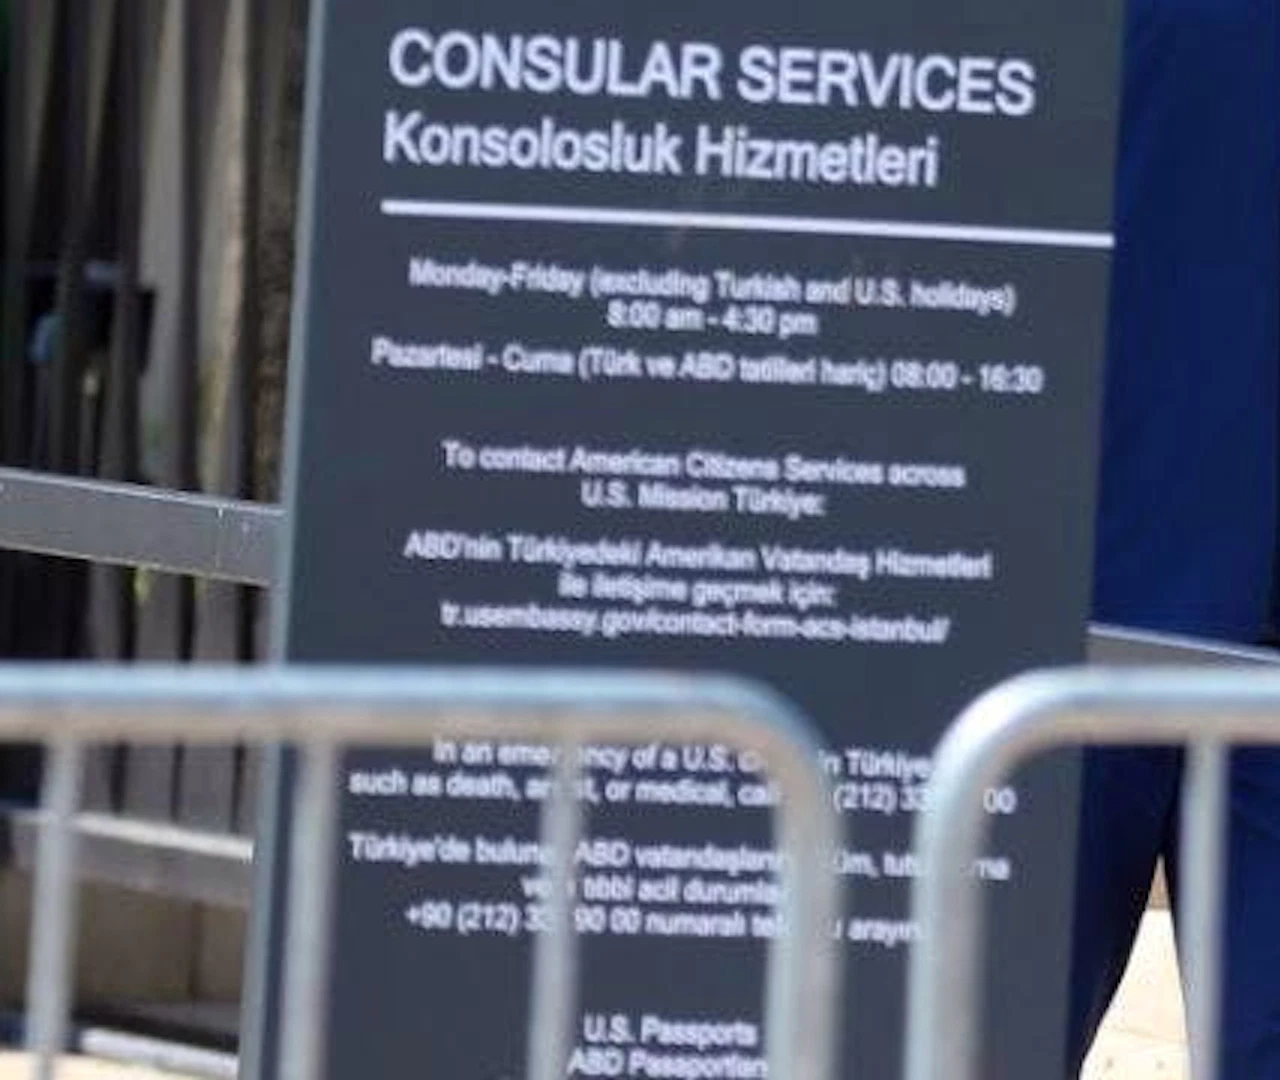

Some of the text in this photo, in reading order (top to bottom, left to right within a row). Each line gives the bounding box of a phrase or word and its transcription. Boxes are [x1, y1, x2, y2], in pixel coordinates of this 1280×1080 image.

[388, 27, 1037, 118] CONSULAR SERVICES
[382, 110, 940, 188] Konsolosluk Hizmetleri
[408, 257, 1017, 317] Monday-Friday (excluding Turkish and U.S. holidays)
[607, 299, 663, 329] 8:00
[666, 307, 705, 331] am
[722, 304, 777, 334] 4:30
[779, 311, 820, 340] pm
[370, 335, 485, 371] Pazartesi
[502, 342, 575, 375] Cuma
[577, 345, 643, 383] (Türk
[646, 355, 676, 379] ve
[678, 351, 737, 382] ABD
[739, 356, 817, 386] tatilleri
[820, 358, 888, 394] hariç)
[890, 359, 960, 391] 08:00
[979, 364, 1045, 395] 16:30
[442, 439, 968, 489] To contact American Citizens Services across
[580, 478, 829, 520] U.S. Mission Türkiye:
[403, 530, 502, 564] ABD'nin
[644, 540, 757, 574] Amerikan
[759, 544, 871, 584] Vatandaş
[874, 548, 992, 582] Hizmetleri
[557, 573, 589, 599] ile
[591, 574, 687, 606] iletişime
[692, 579, 783, 610] geçmek
[439, 599, 952, 645] tr.usembassy.gov/contact-form-acs-istanbul/
[432, 738, 457, 763] In
[461, 743, 493, 765] an
[631, 742, 659, 770] of
[660, 751, 678, 771] a
[683, 746, 735, 774] U.S.
[348, 770, 408, 796] such
[411, 775, 441, 797] as
[445, 771, 522, 802] death,
[604, 781, 633, 804] or
[634, 779, 734, 809] medical,
[832, 783, 898, 816] (212)
[347, 831, 631, 869] Türkiye'de ABD
[637, 876, 681, 903] acil
[403, 902, 453, 931] +90
[457, 902, 520, 938] (212)
[609, 906, 643, 936] 00
[644, 910, 747, 939] numaralı
[582, 1013, 759, 1053] U.S. Passports
[565, 1046, 626, 1076] ABD
